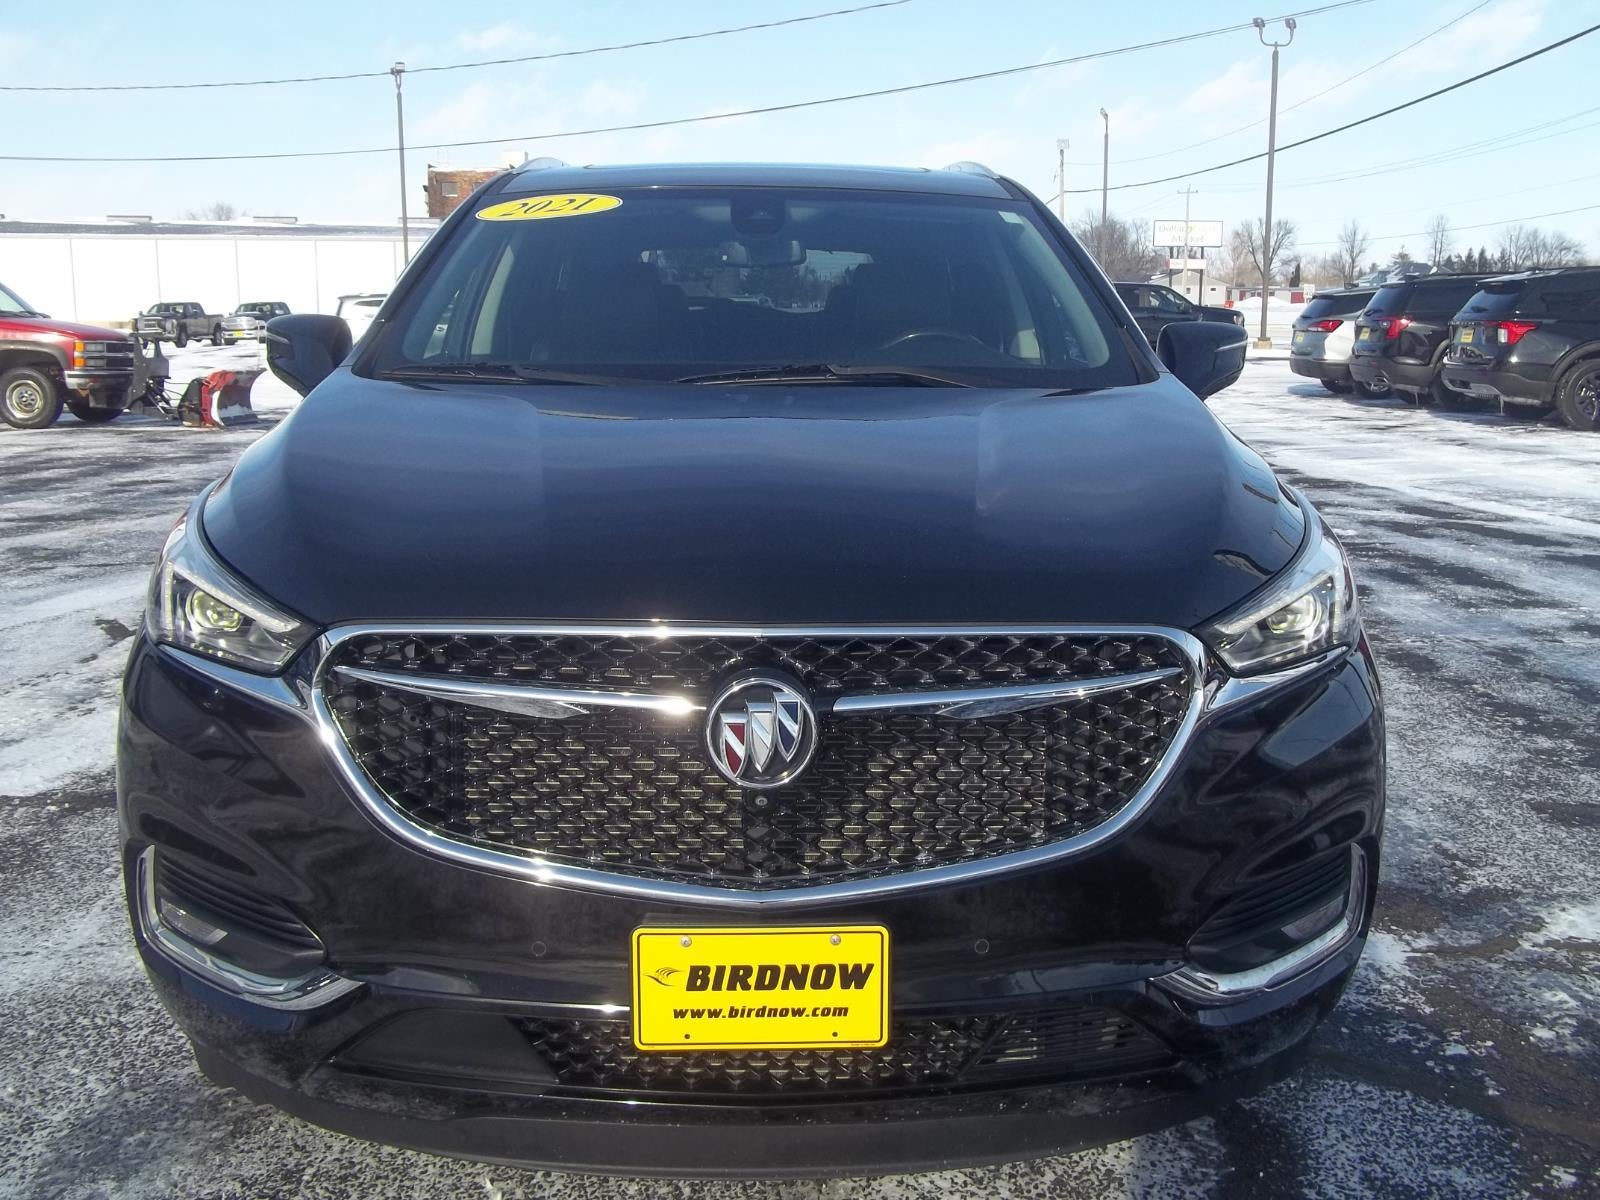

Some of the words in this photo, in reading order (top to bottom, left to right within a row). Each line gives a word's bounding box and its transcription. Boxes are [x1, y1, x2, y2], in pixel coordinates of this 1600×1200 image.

[498, 197, 598, 217] 2021
[685, 963, 875, 992] BIRDNOW
[673, 1005, 849, 1019] www.birdnow.com
